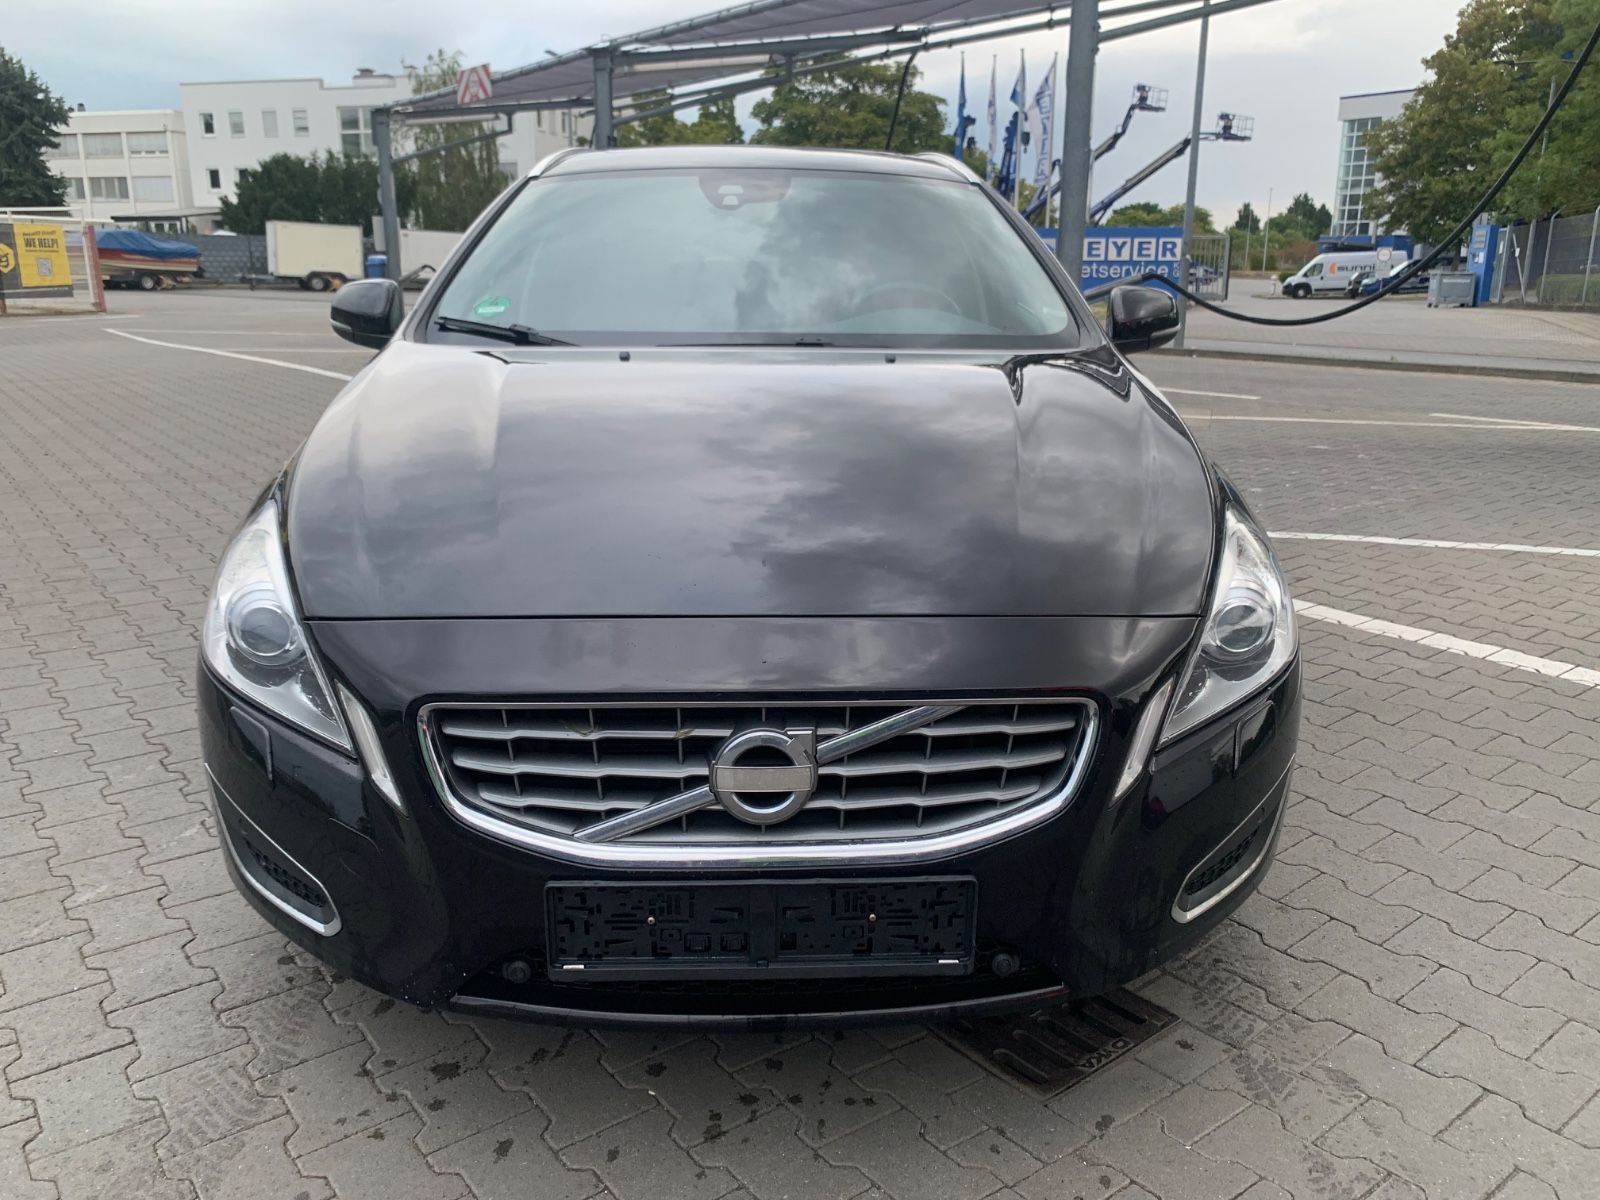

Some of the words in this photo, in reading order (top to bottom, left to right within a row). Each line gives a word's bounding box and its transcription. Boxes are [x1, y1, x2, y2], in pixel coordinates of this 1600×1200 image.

[23, 238, 37, 248] WE
[1086, 240, 1178, 257] EYER
[1081, 261, 1169, 278] etservice
